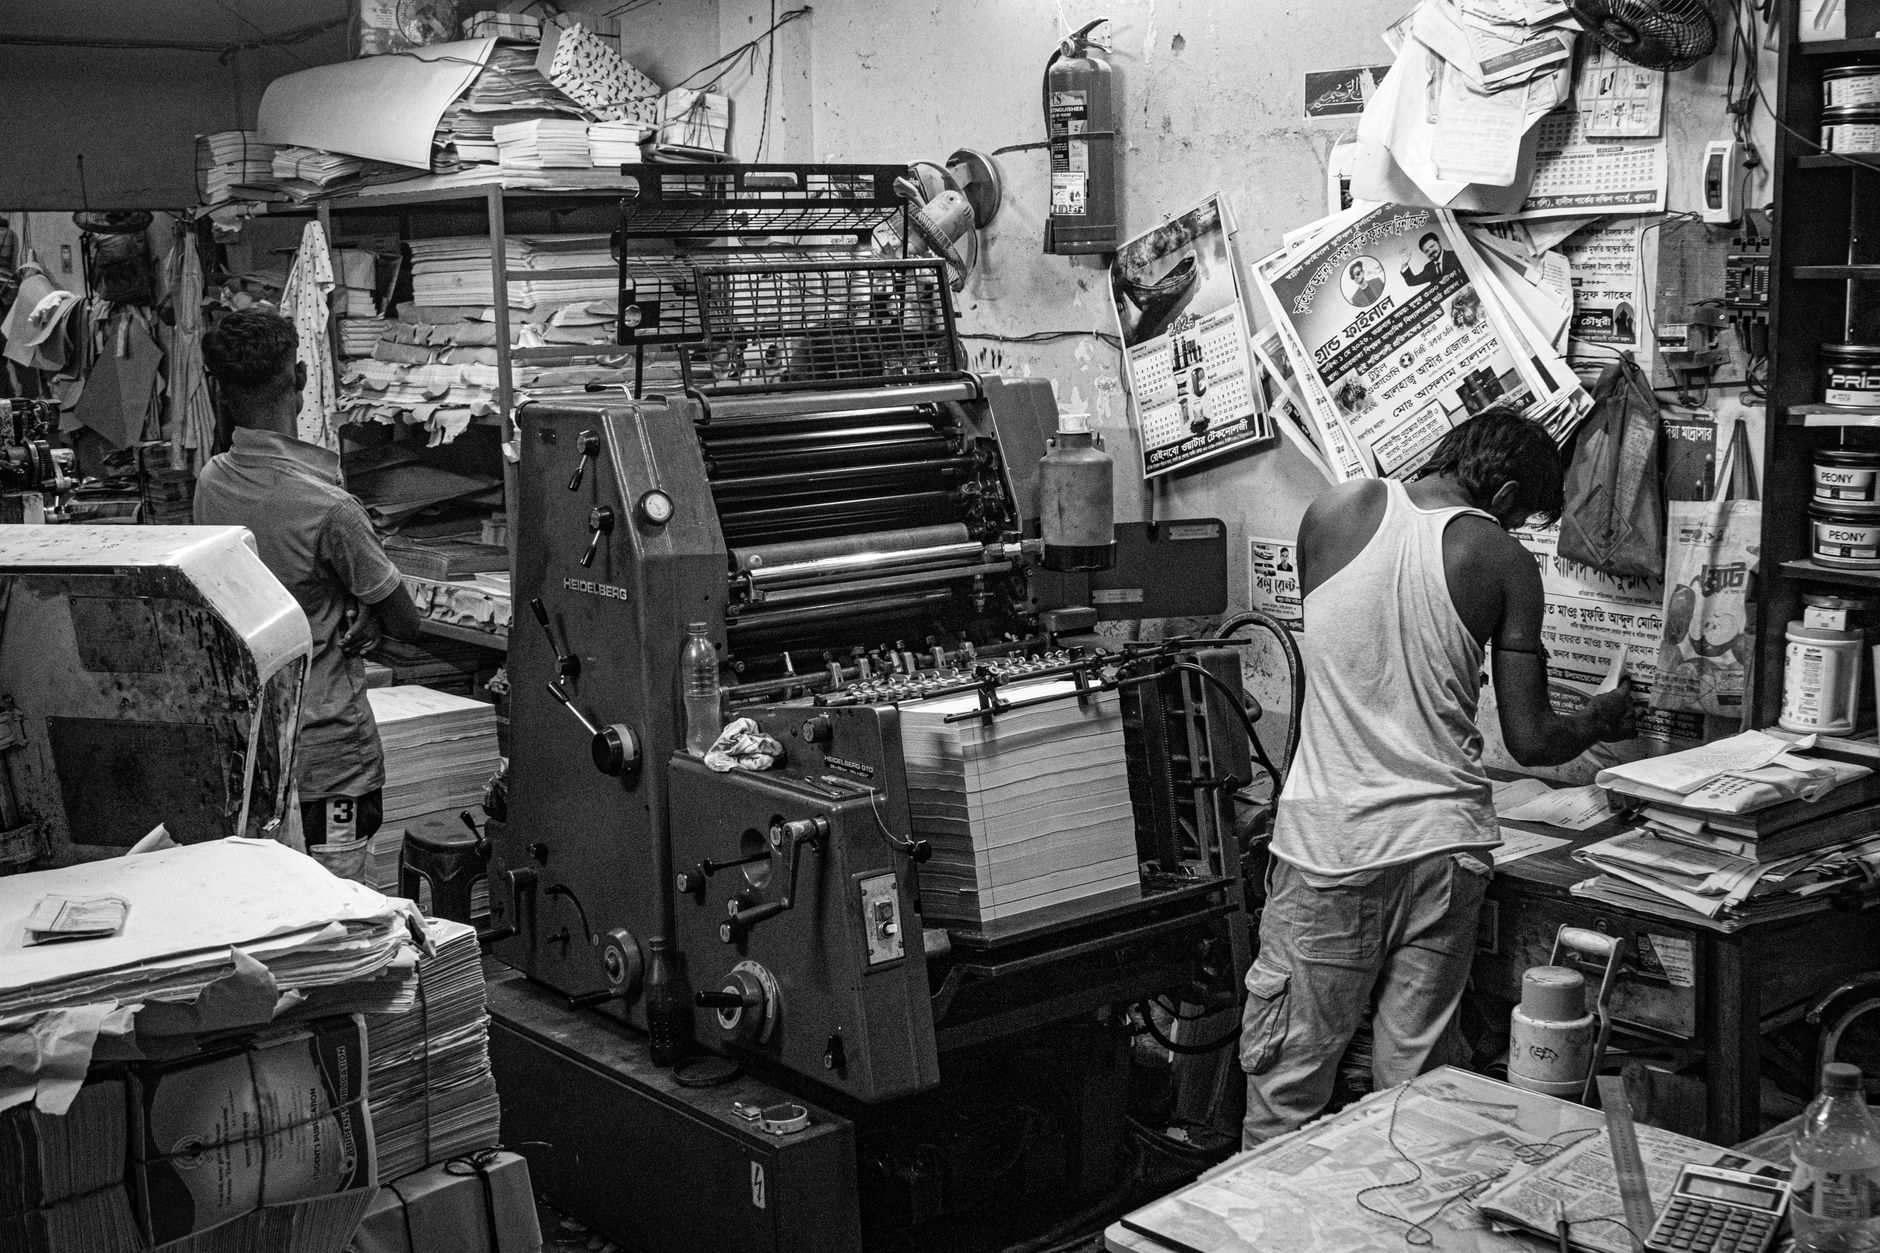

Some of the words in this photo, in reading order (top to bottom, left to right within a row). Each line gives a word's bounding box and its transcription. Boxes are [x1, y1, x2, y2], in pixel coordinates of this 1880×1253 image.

[1573, 288, 1599, 301] উসুফ
[1603, 291, 1633, 300] সাহেব
[1168, 315, 1196, 337] 2025
[1342, 295, 1395, 340] ফাইনাল
[1581, 315, 1611, 328] চৌধুরী
[1415, 352, 1441, 376] আমীর
[1472, 321, 1488, 336] খান
[1415, 368, 1455, 400] আসলাম
[1459, 338, 1498, 369] হালদার
[1681, 425, 1713, 442] মাদ্রাসার
[1821, 471, 1854, 484] PEONY
[1829, 529, 1866, 542] PEONY
[563, 577, 628, 601] HEIDELBERG
[1580, 604, 1605, 625] মুফতি
[825, 755, 860, 770] HEIDELBERG
[333, 799, 353, 823] 3
[310, 1087, 320, 1140] PUBLCATION
